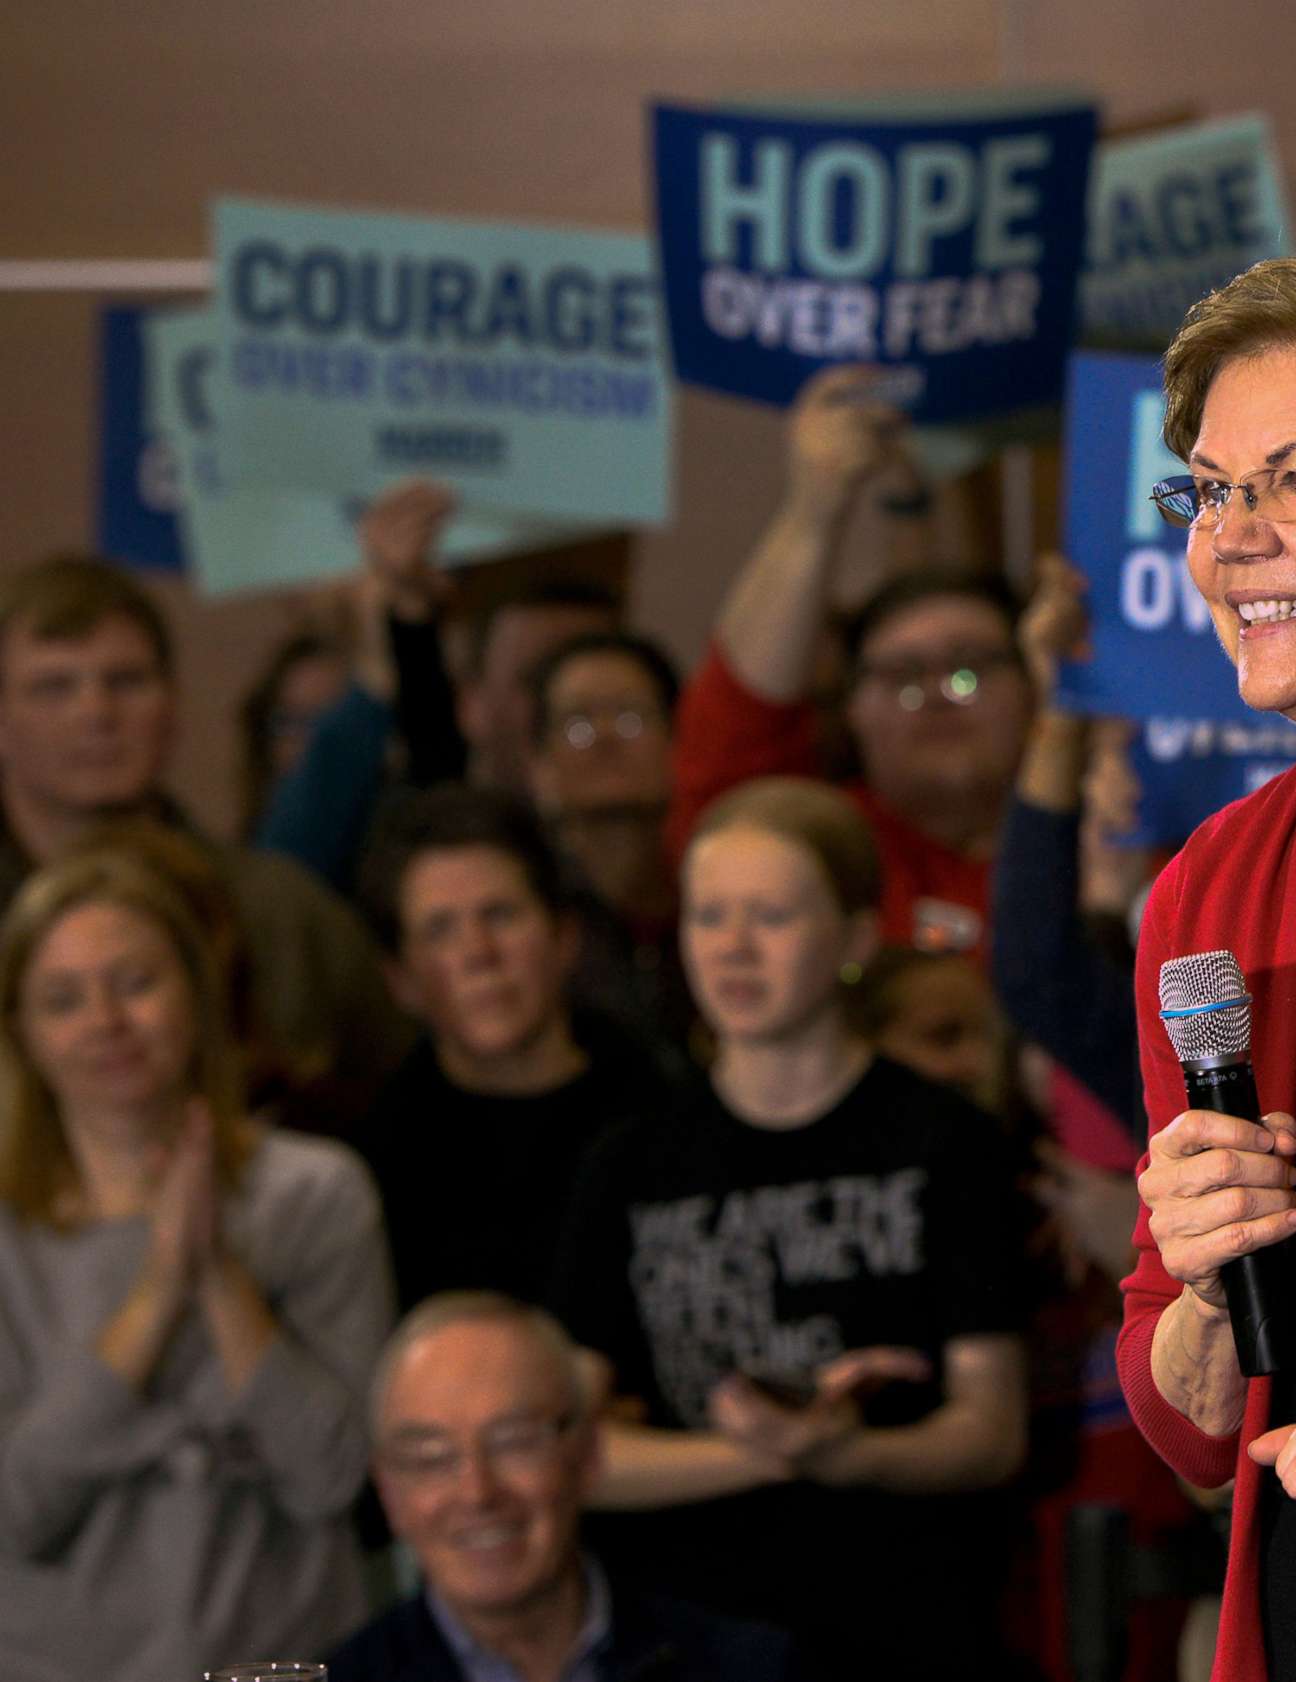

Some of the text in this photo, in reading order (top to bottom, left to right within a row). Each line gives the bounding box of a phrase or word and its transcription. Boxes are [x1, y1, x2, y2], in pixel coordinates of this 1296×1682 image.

[702, 132, 1048, 277] HOPE
[230, 240, 656, 360] COURAGE
[702, 266, 878, 357] OVER
[886, 270, 1042, 356] FEAR
